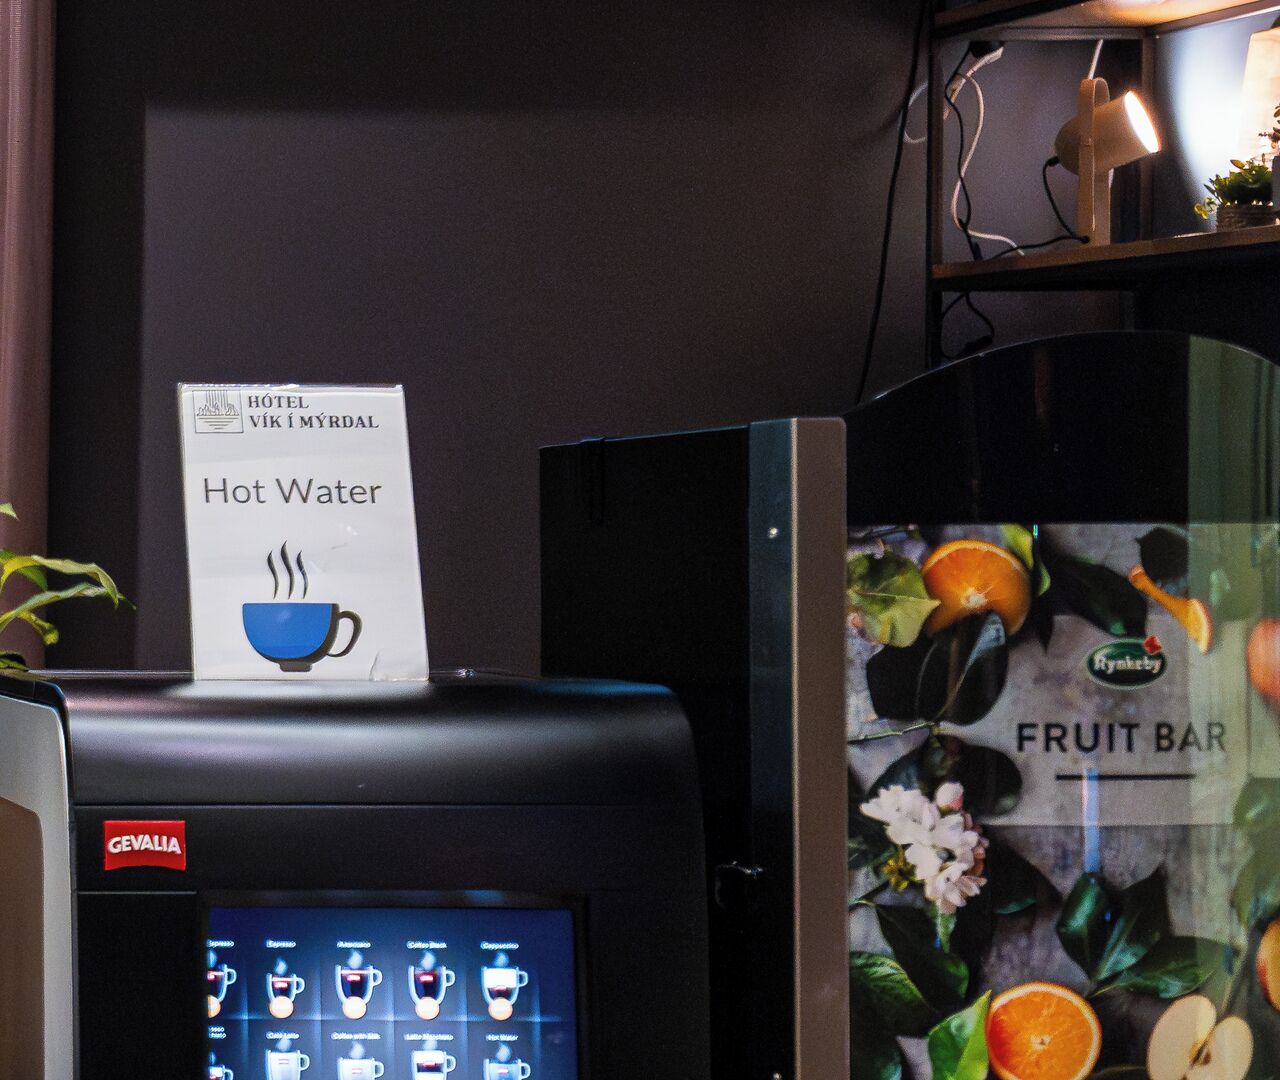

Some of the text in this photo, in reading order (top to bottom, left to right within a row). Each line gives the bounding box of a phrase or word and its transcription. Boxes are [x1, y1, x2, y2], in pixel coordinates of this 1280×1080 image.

[248, 393, 309, 409] HÓTEL
[250, 412, 380, 429] VÍK Í MÝRDAL
[204, 478, 382, 504] Hot Water
[1017, 721, 1226, 752] FRUIT BAR
[108, 834, 182, 854] GEVALIA
